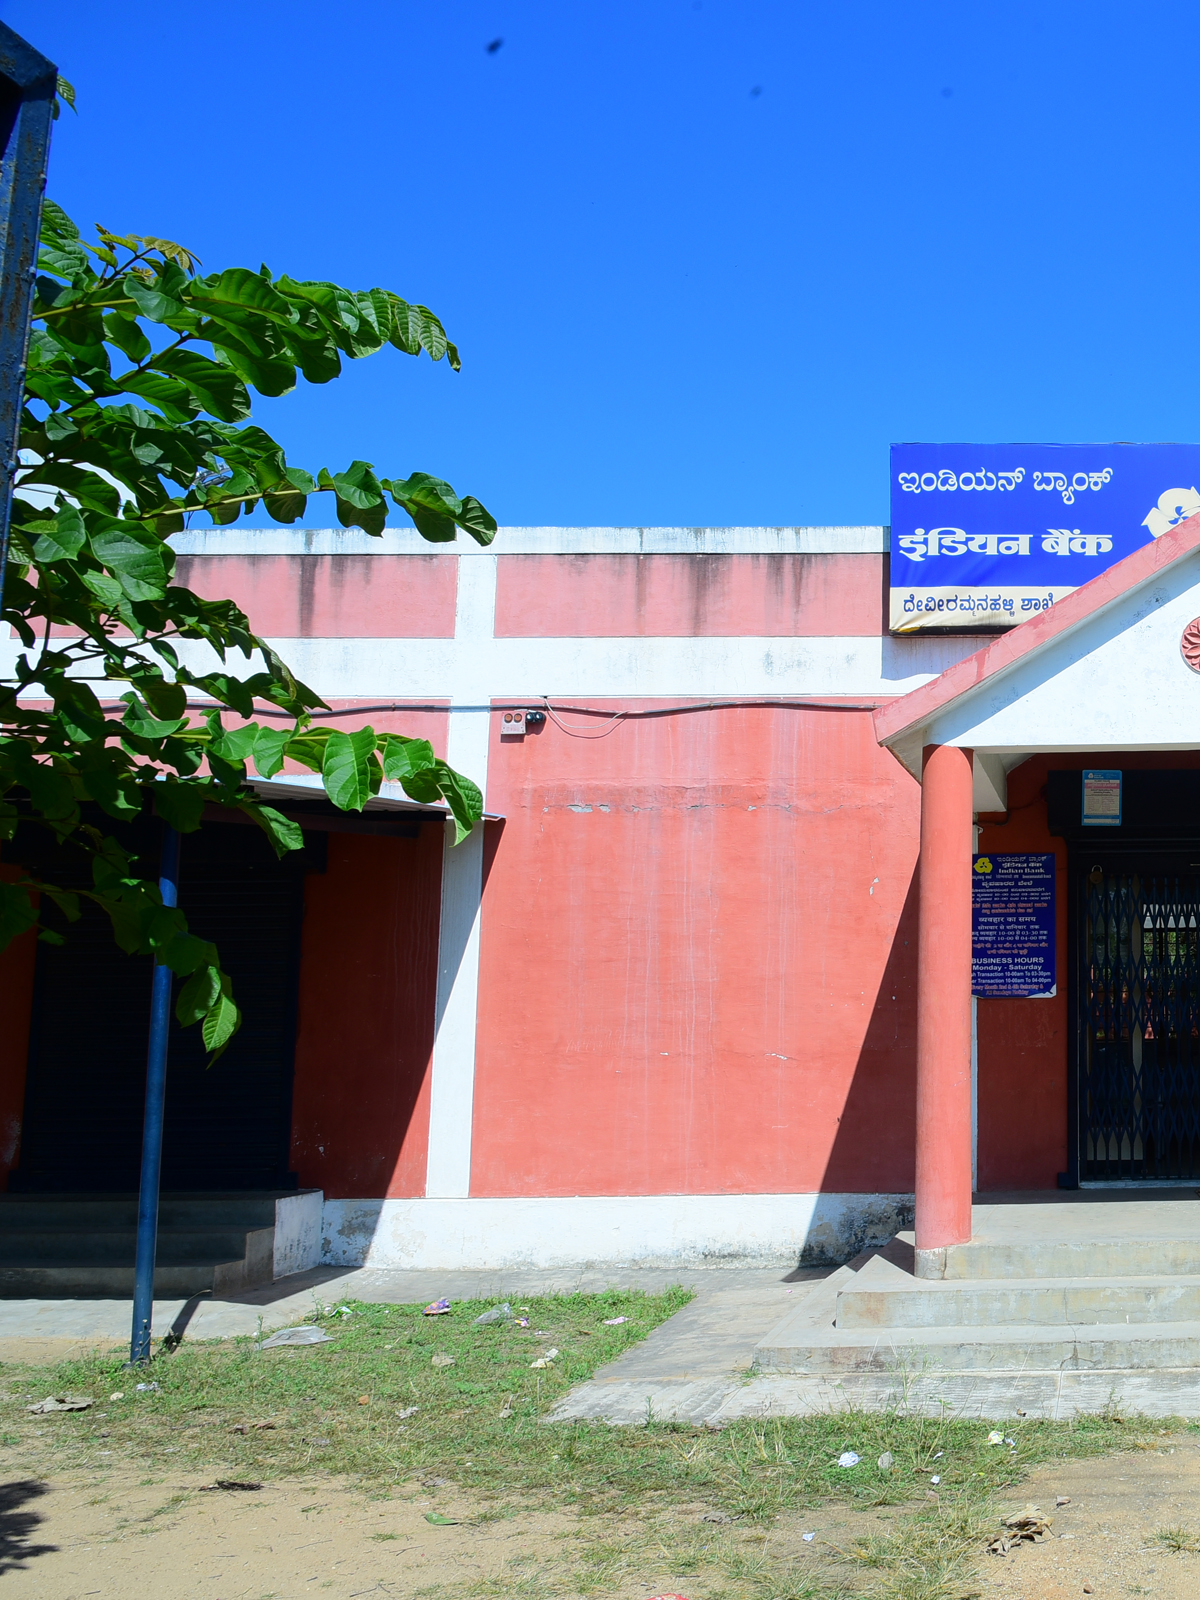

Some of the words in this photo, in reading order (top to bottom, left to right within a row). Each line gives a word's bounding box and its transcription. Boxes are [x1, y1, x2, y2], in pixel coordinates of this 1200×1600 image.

[898, 467, 1026, 494] ಇಂಡಿಯನ್
[1032, 467, 1113, 505] ಬ್ಯಾಂಕ್
[898, 527, 1033, 562] इंडियन
[1041, 528, 1113, 556] बैंक
